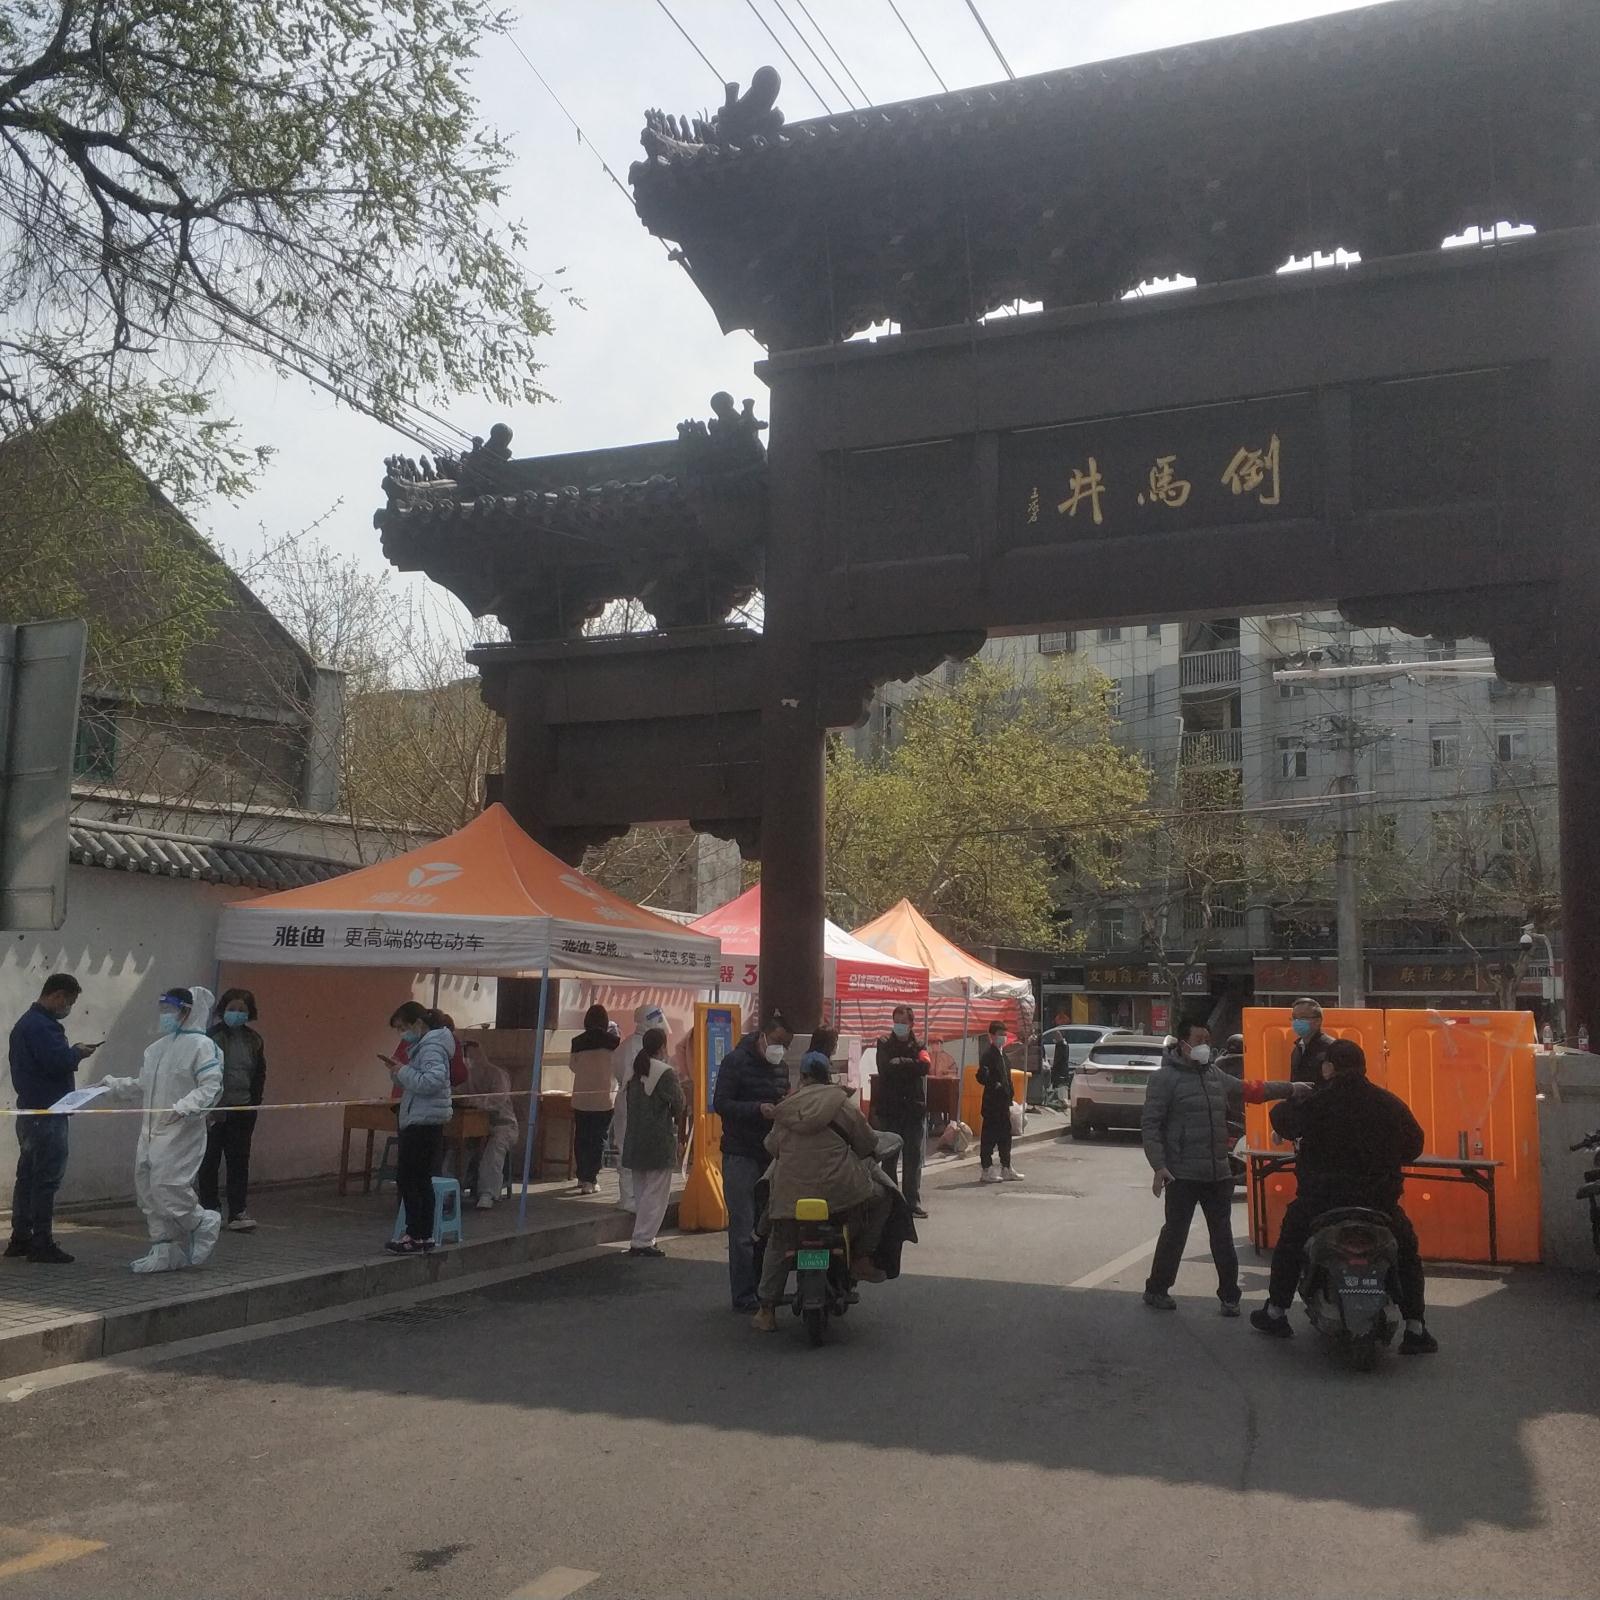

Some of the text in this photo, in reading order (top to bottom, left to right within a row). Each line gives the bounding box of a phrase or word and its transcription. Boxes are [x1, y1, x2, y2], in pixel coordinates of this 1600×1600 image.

[273, 925, 485, 952] 雅迪 更高端的电动车
[742, 964, 758, 986] 3
